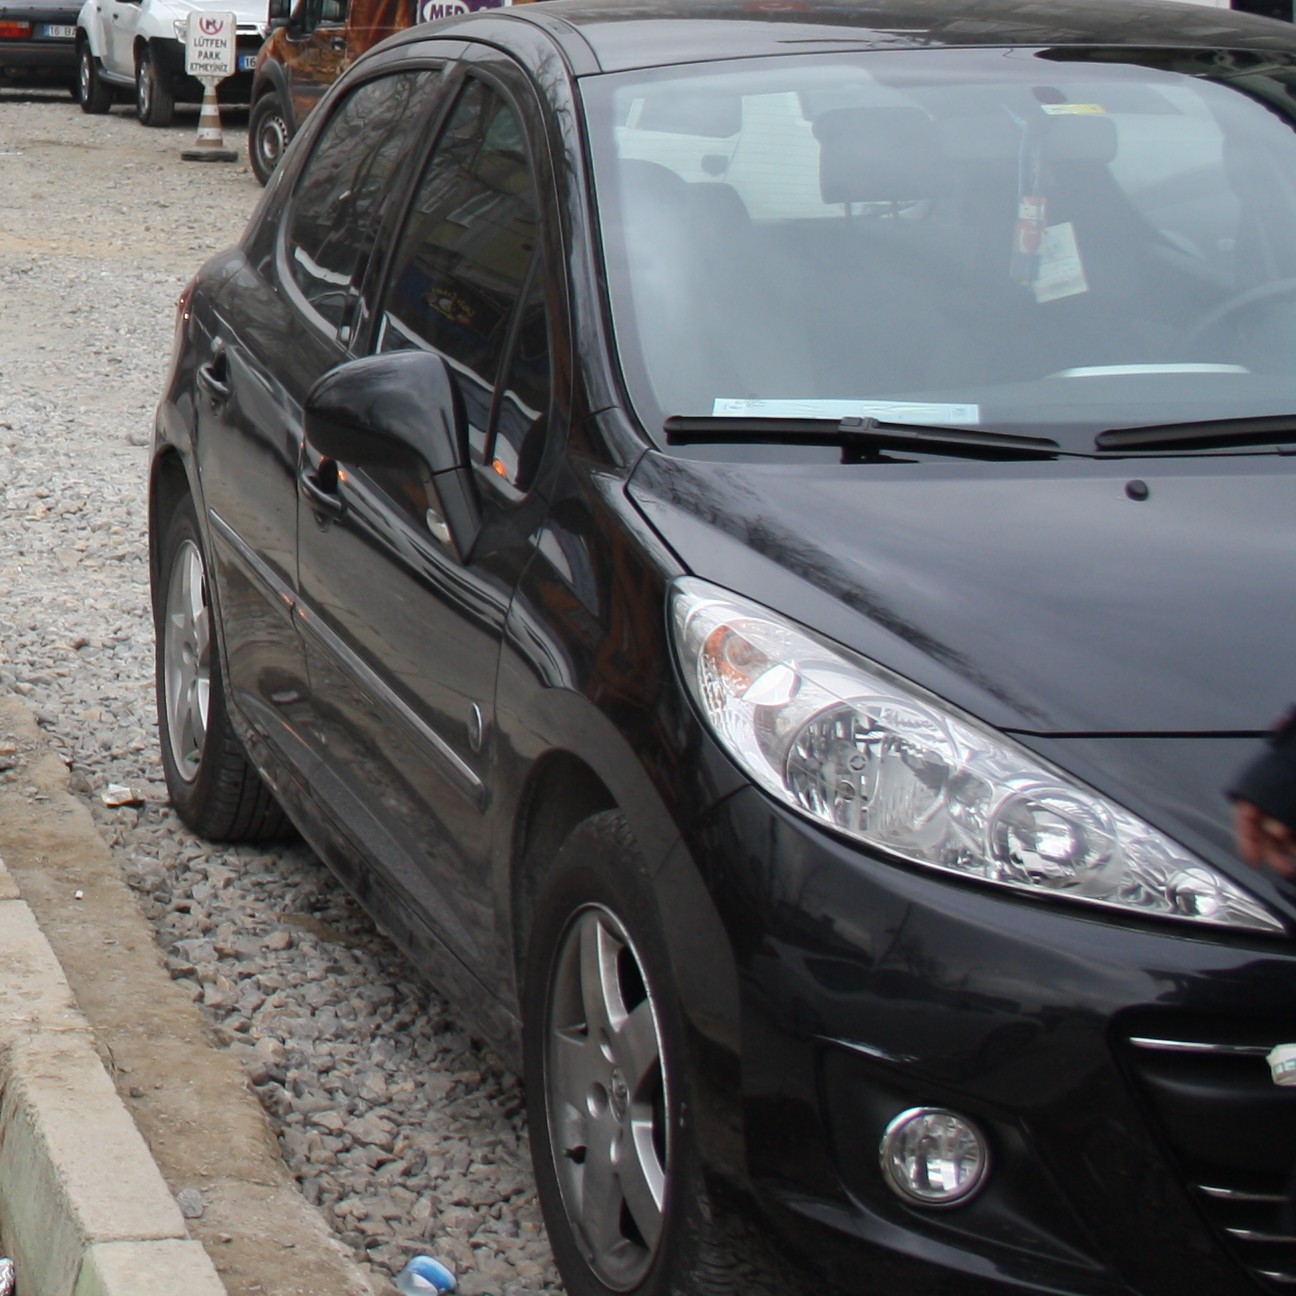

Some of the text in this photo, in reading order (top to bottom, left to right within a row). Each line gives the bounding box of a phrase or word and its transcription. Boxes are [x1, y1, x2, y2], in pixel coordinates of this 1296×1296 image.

[193, 35, 227, 48] LÜTFEN
[197, 50, 221, 60] PARK
[189, 62, 228, 73] ETMEYİNİZ
